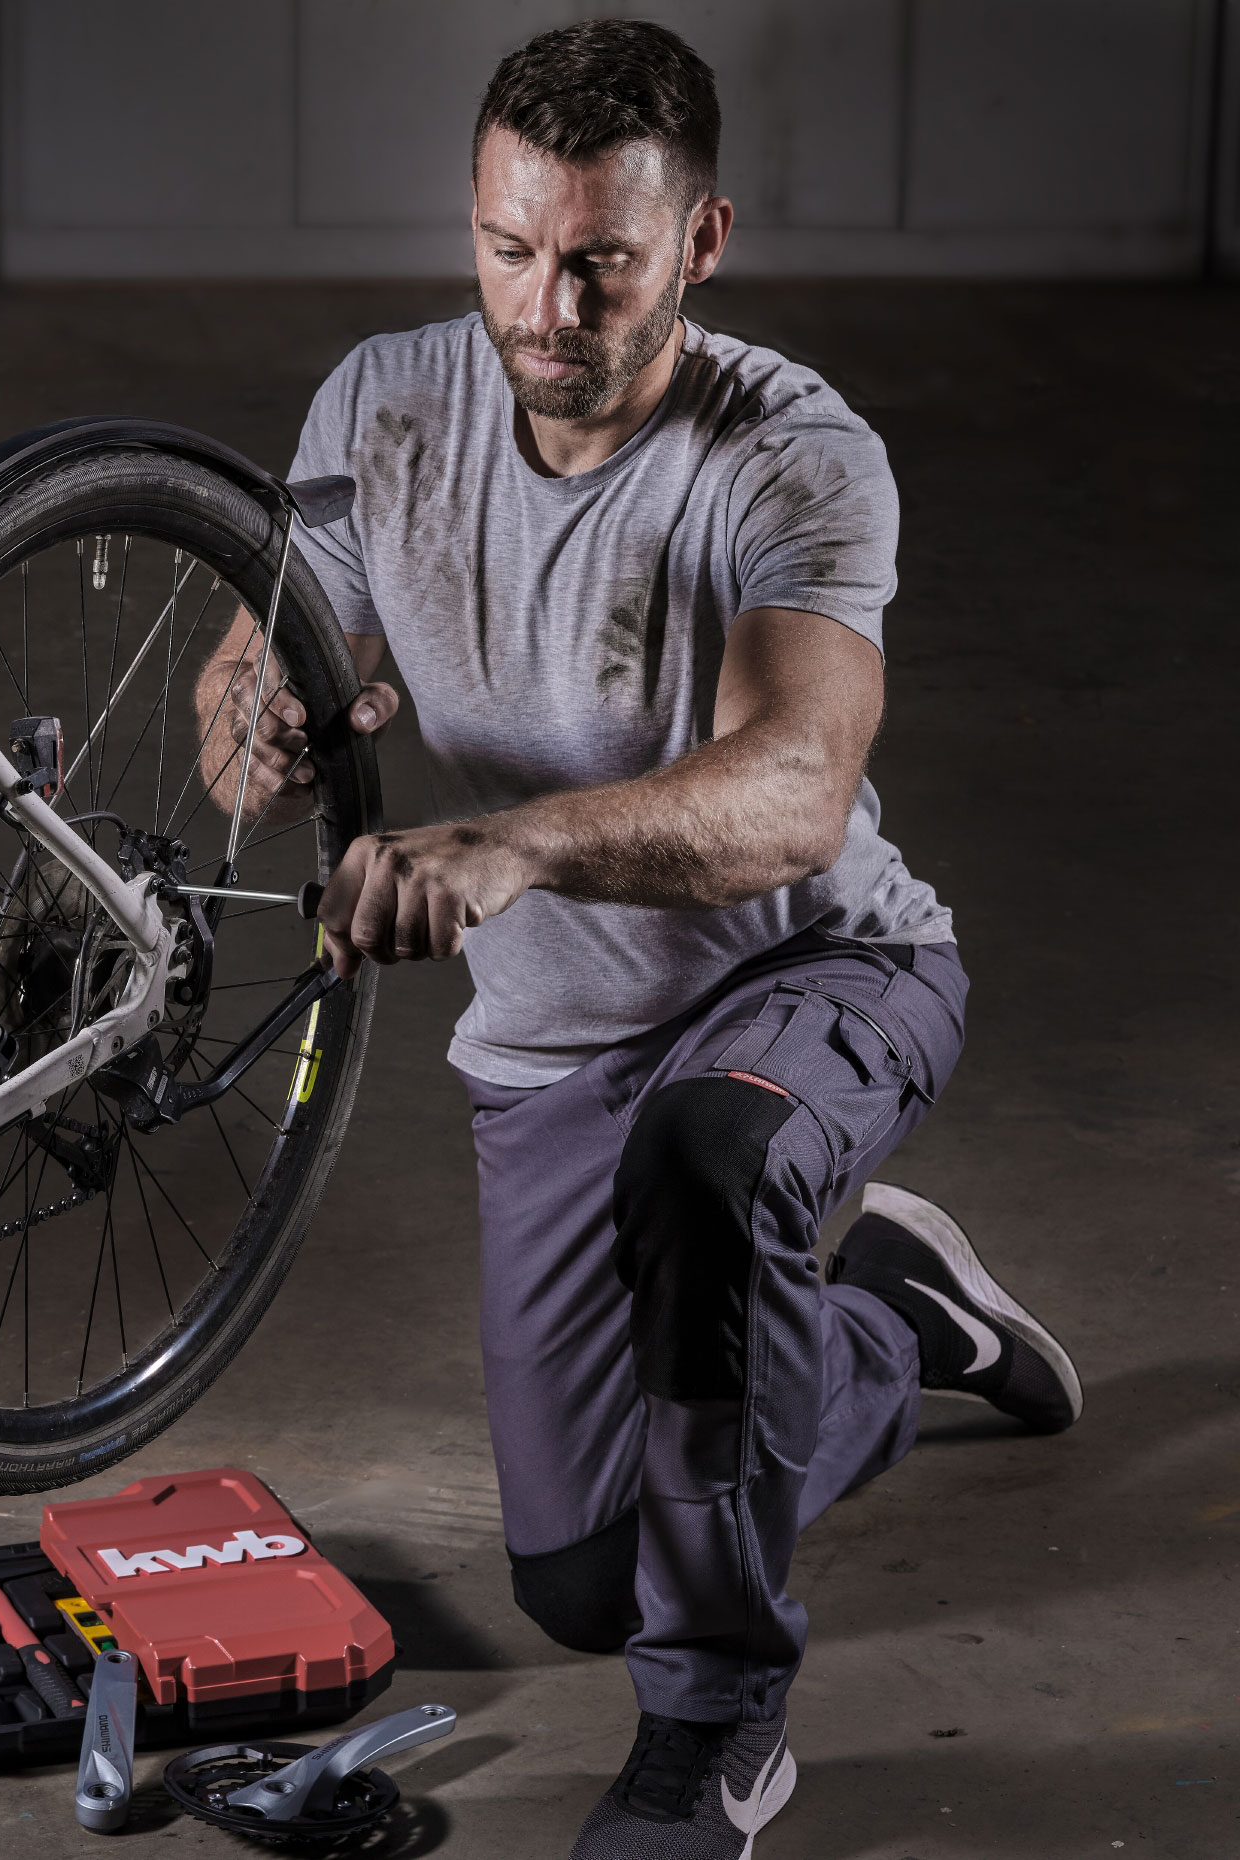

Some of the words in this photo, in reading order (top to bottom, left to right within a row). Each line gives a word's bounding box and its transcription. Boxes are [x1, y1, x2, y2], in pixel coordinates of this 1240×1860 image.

[97, 1530, 305, 1579] kwb
[98, 1714, 112, 1753] SHIMANO
[312, 1735, 352, 1761] SHIMANO
